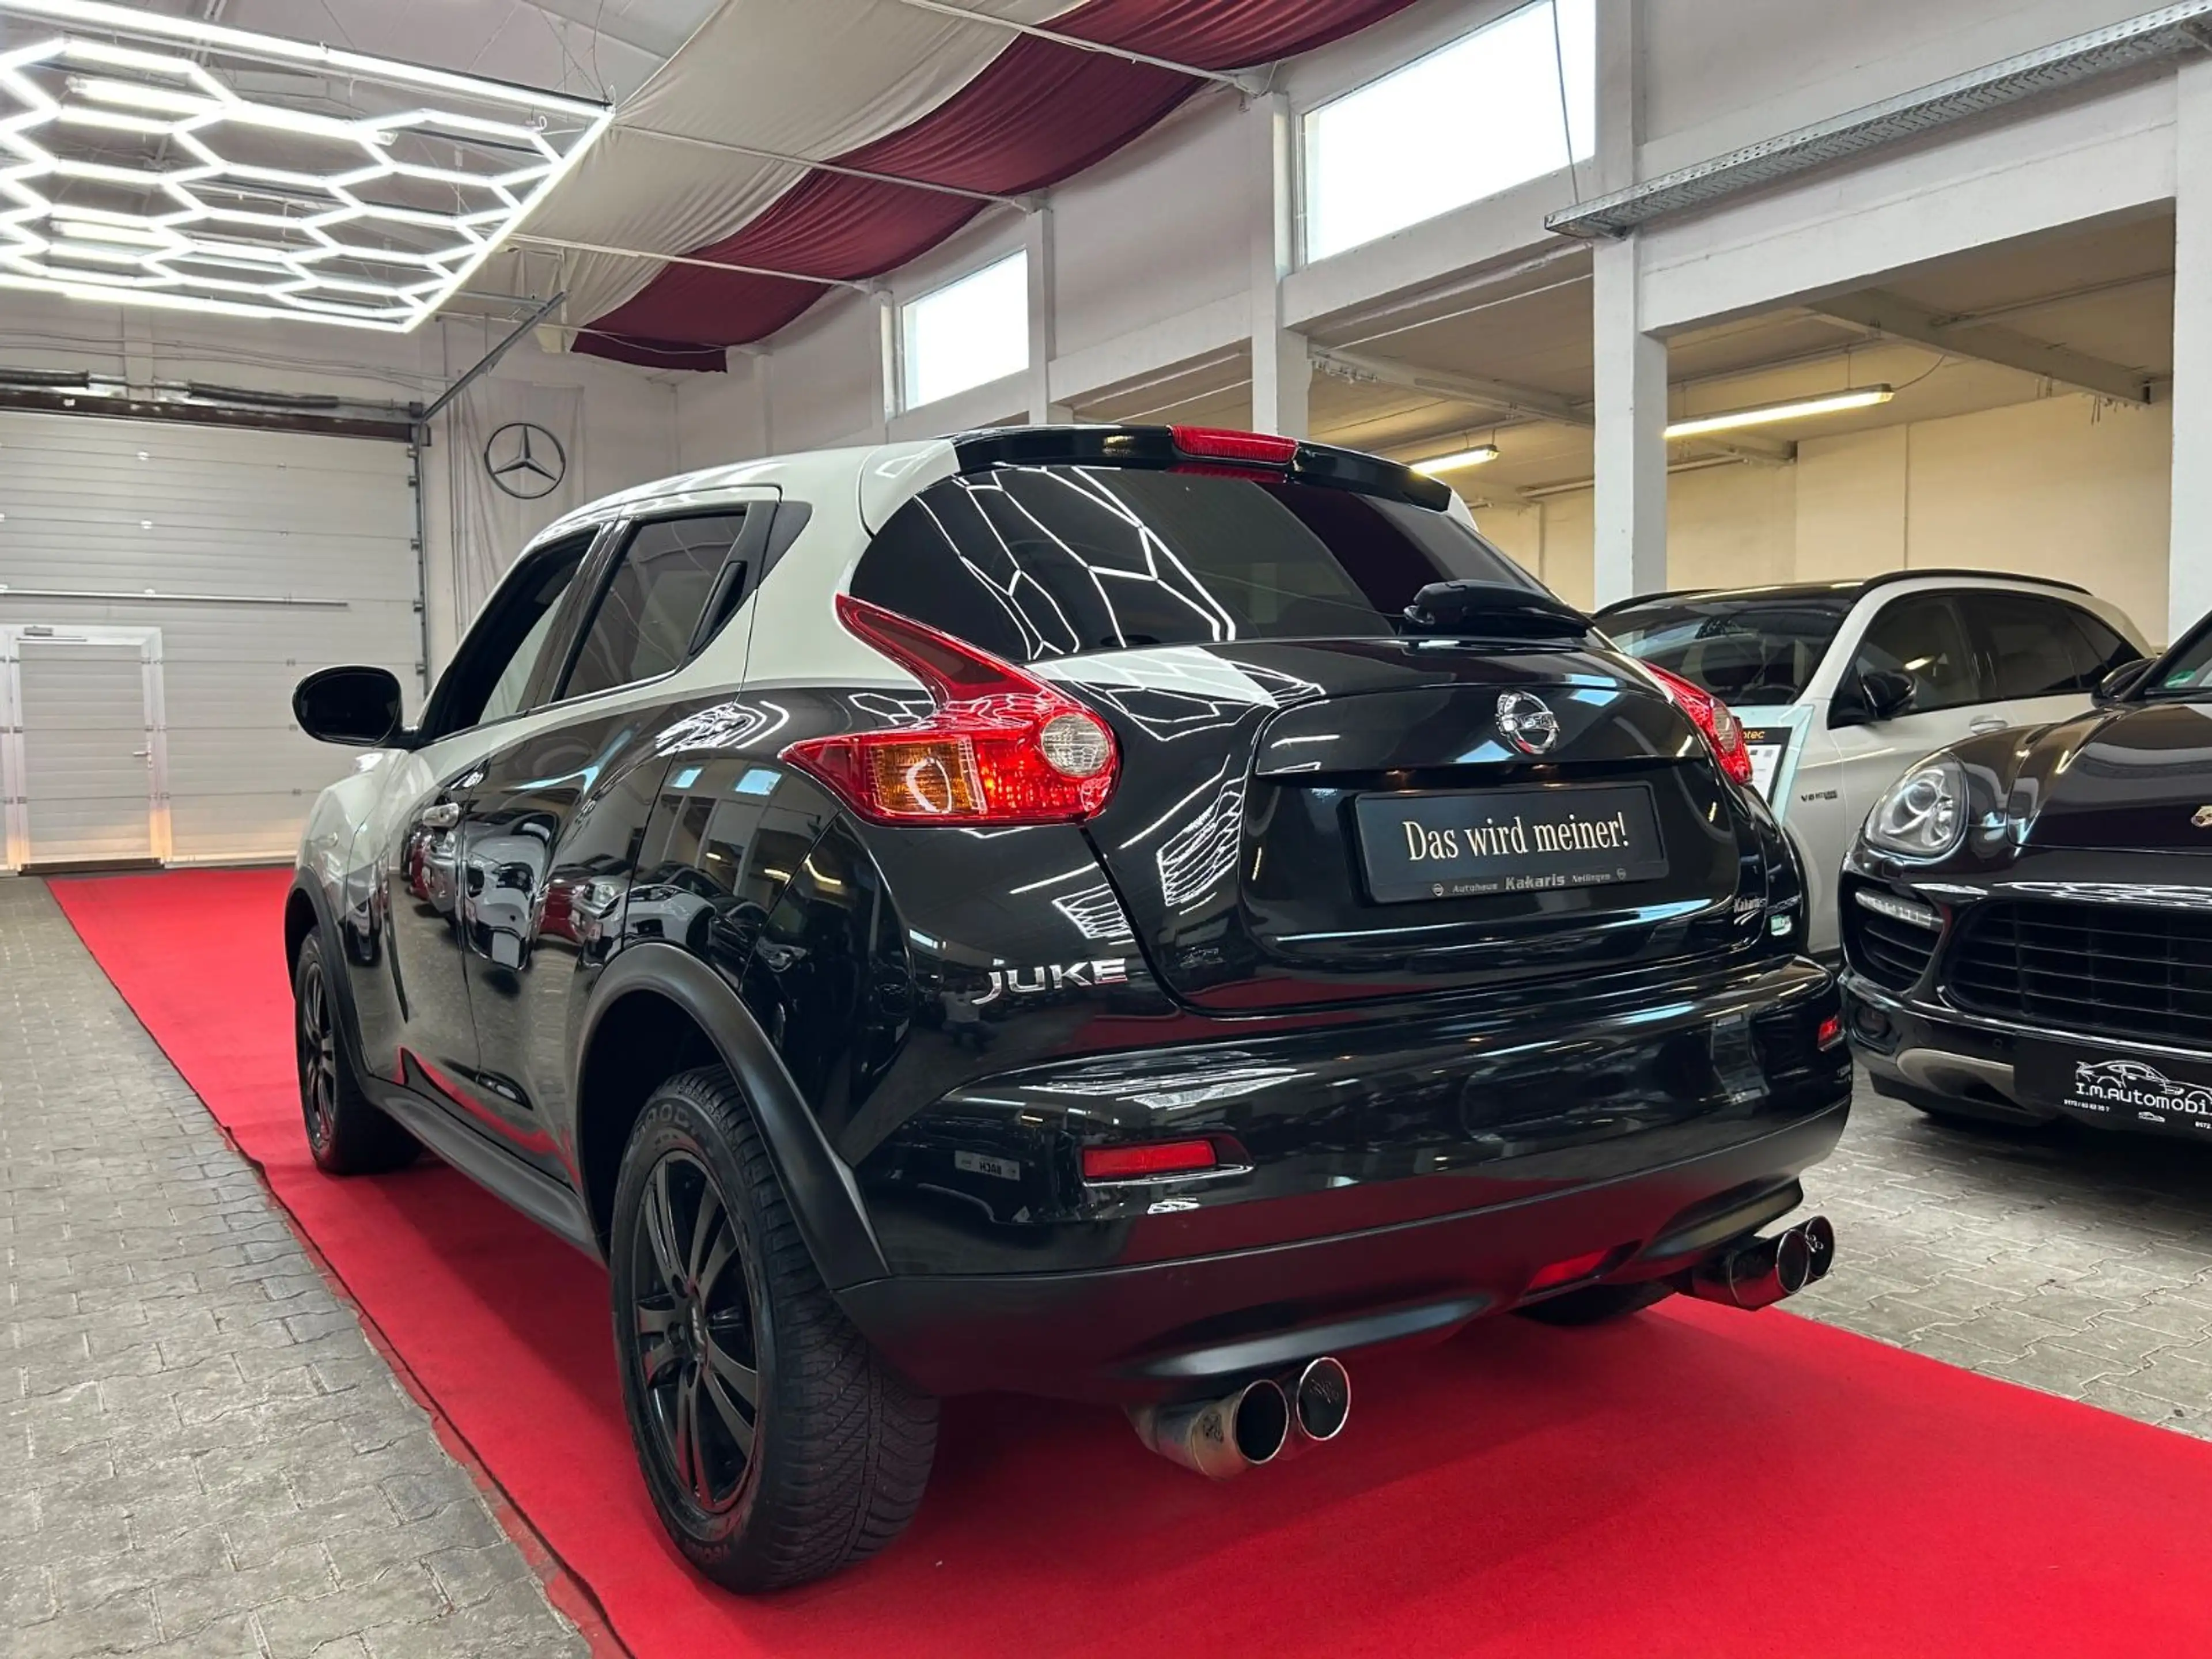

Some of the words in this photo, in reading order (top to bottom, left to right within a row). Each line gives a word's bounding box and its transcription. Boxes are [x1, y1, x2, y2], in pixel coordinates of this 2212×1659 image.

[1403, 821, 1459, 861] Das
[1464, 816, 1528, 857] wird
[1533, 811, 1629, 853] meiner!
[1505, 873, 1565, 891] Kakaris
